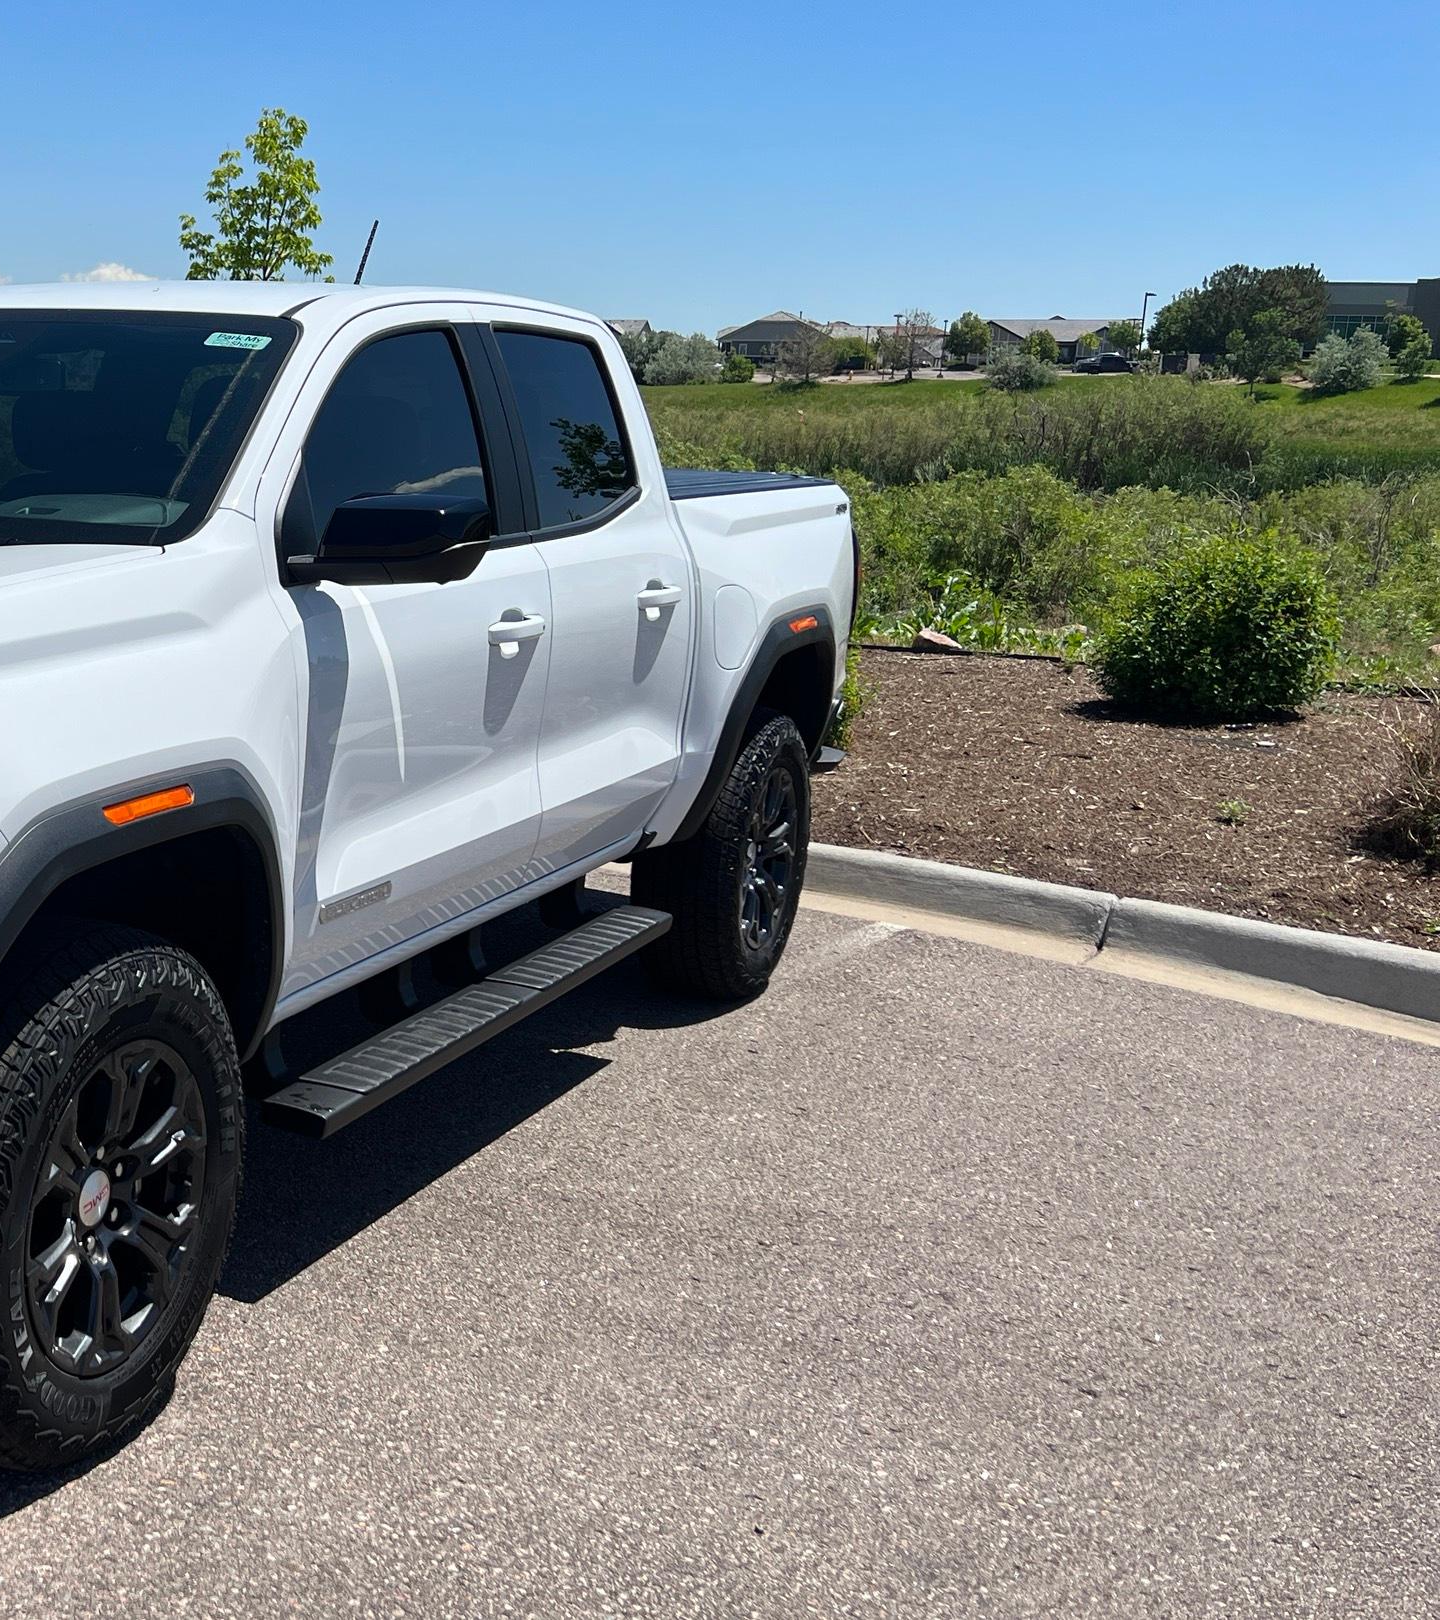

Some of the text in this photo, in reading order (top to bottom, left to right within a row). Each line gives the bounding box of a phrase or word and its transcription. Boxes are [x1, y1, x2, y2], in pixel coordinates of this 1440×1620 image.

[217, 333, 242, 341] Park
[231, 340, 258, 348] Share
[83, 1184, 109, 1215] GMC
[9, 1266, 96, 1424] GOODYEAR
